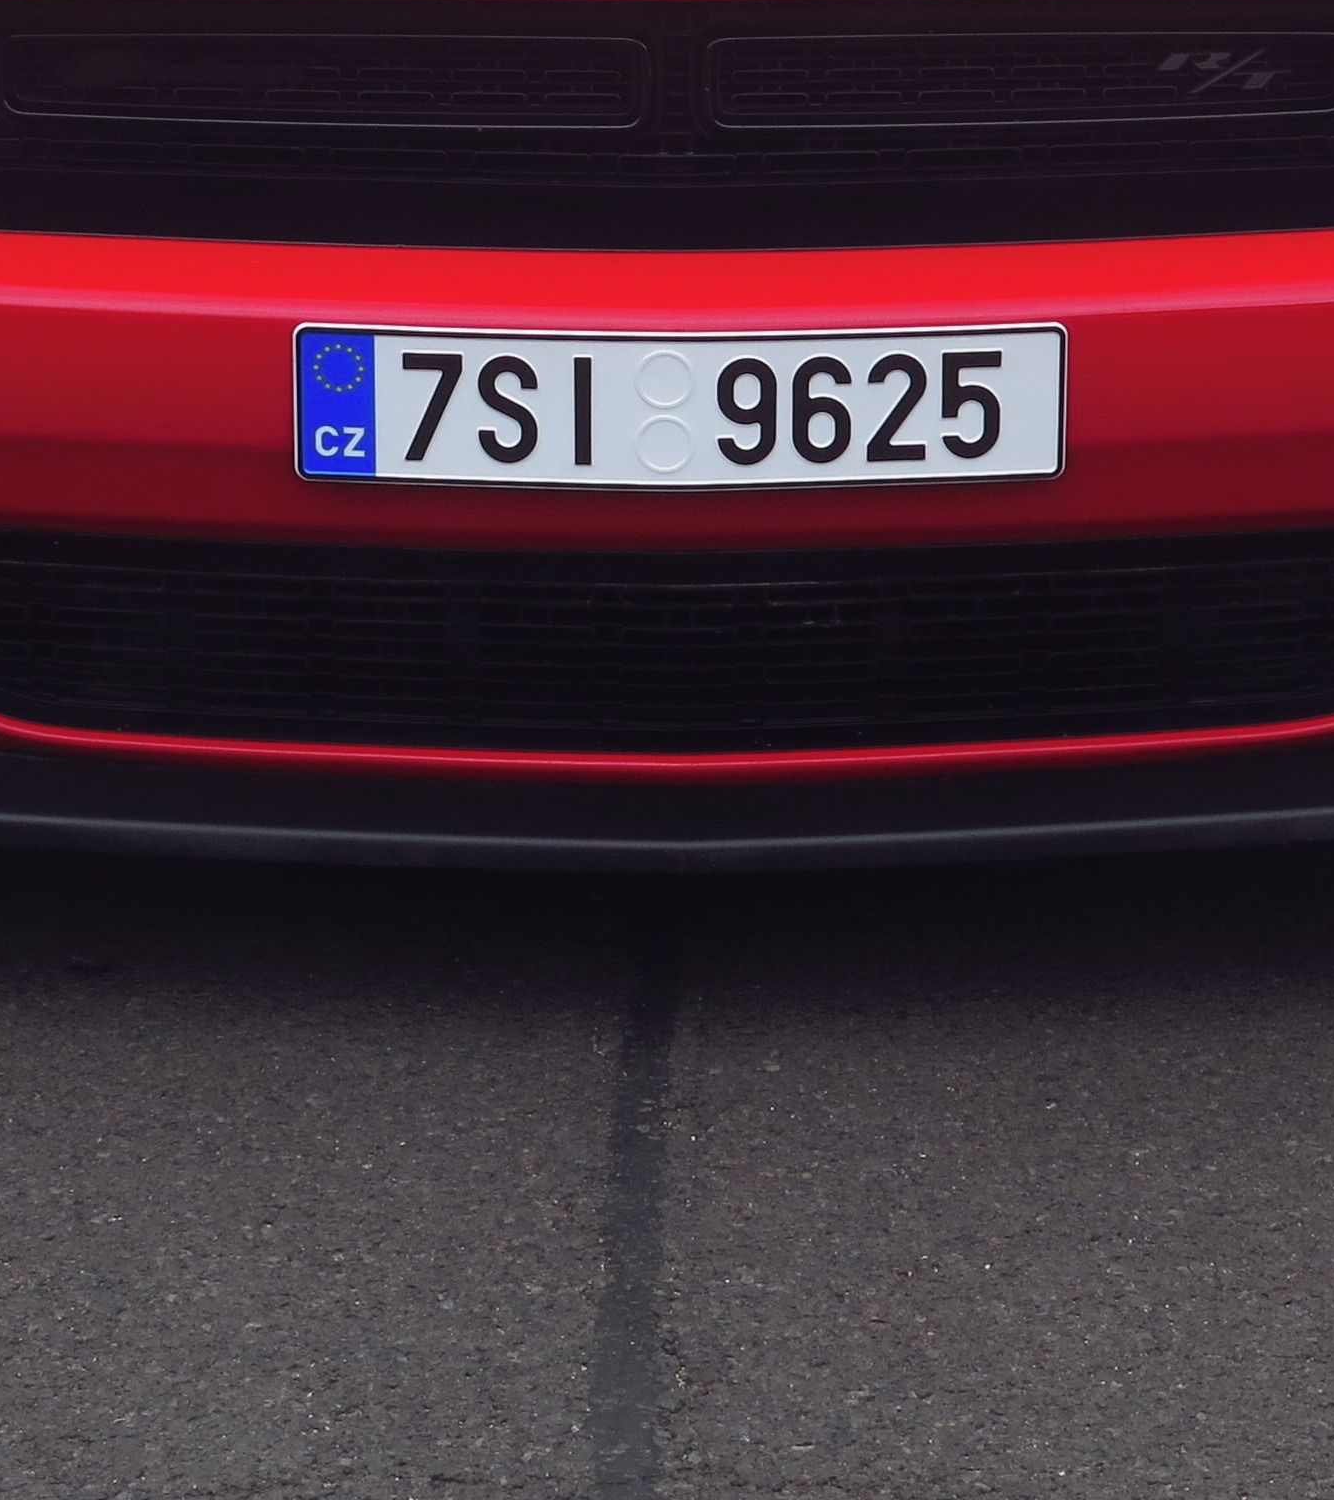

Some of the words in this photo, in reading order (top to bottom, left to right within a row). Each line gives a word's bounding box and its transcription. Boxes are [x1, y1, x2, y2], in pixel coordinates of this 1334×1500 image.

[1157, 47, 1293, 94] R/T
[401, 352, 593, 466] 7SI
[715, 350, 1003, 466] 9625
[314, 425, 366, 458] CZ
